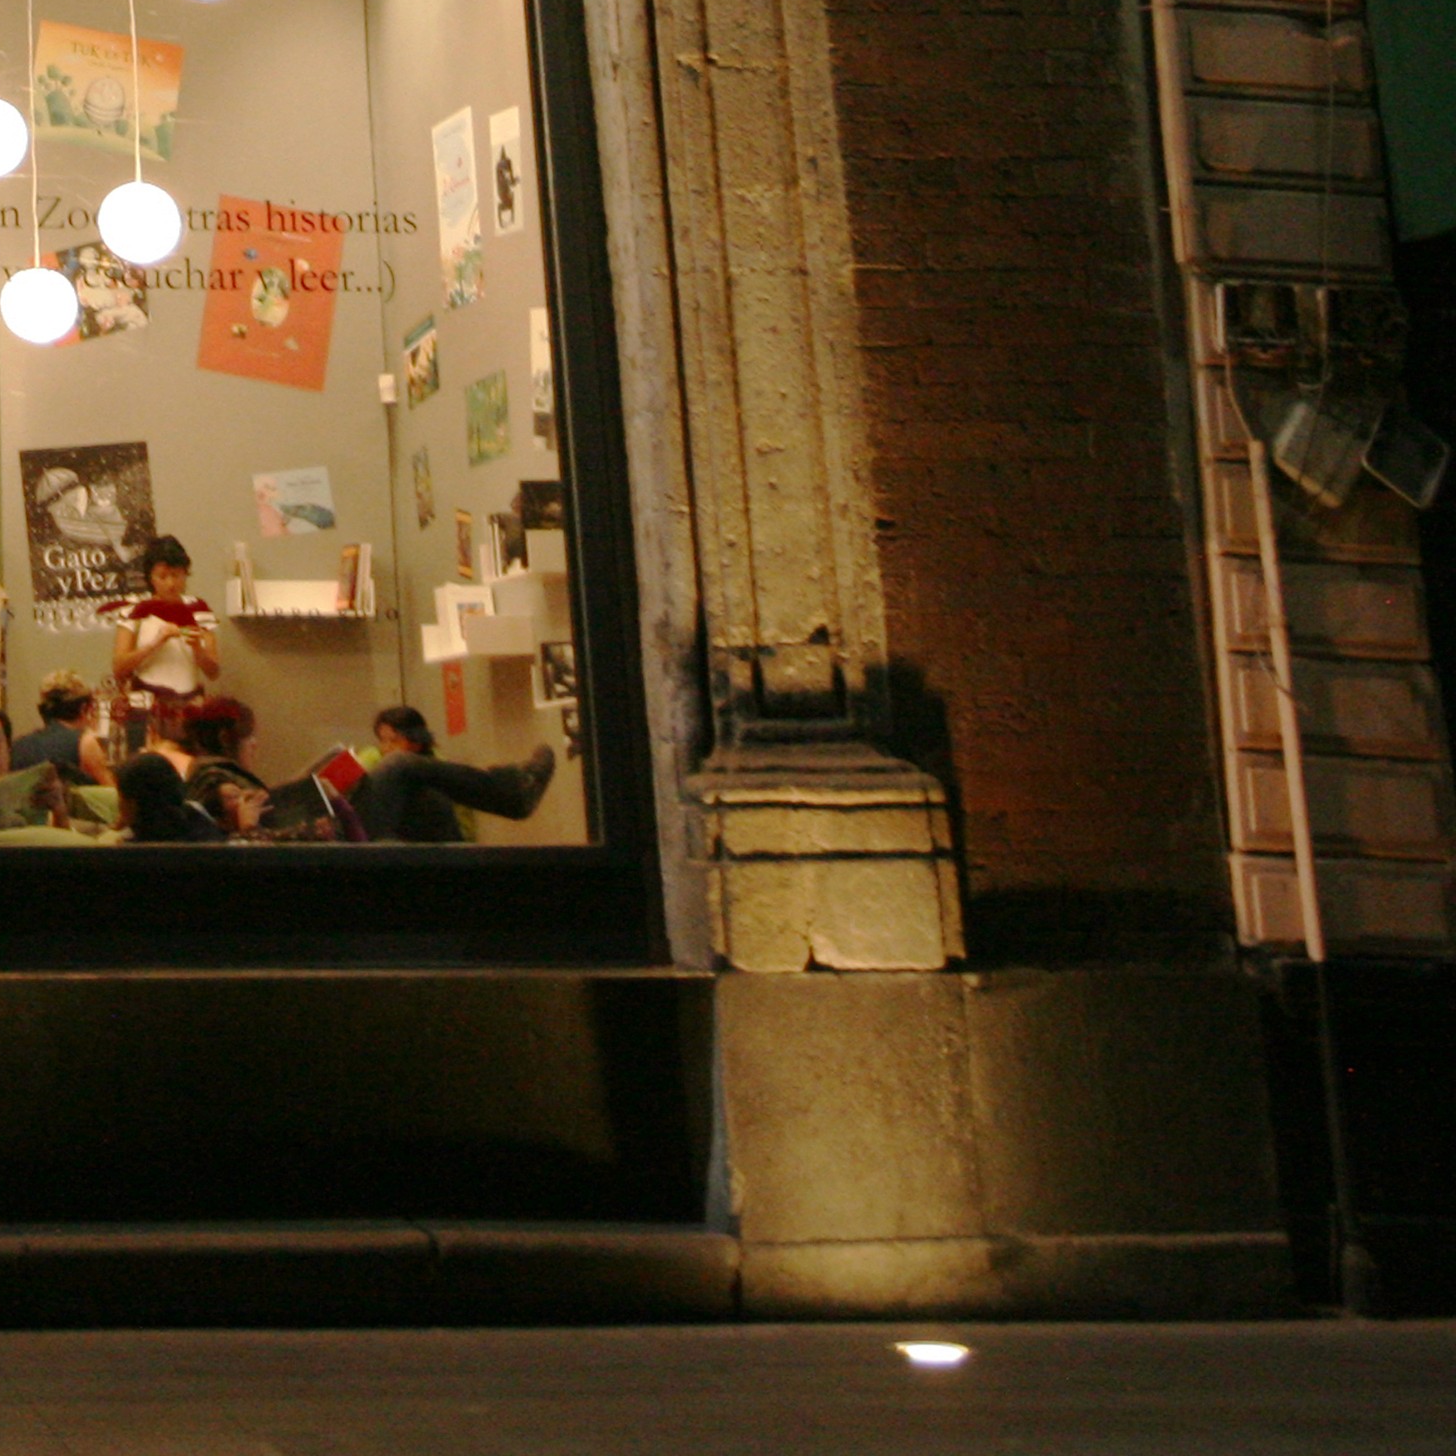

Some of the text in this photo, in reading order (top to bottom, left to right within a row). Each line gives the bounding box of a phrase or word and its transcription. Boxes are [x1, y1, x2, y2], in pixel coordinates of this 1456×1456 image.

[38, 197, 100, 230] Zo
[187, 205, 251, 232] tras
[265, 199, 418, 235] historias
[288, 258, 396, 303] leer...)
[44, 544, 107, 571] Gato
[74, 567, 119, 593] Pez
